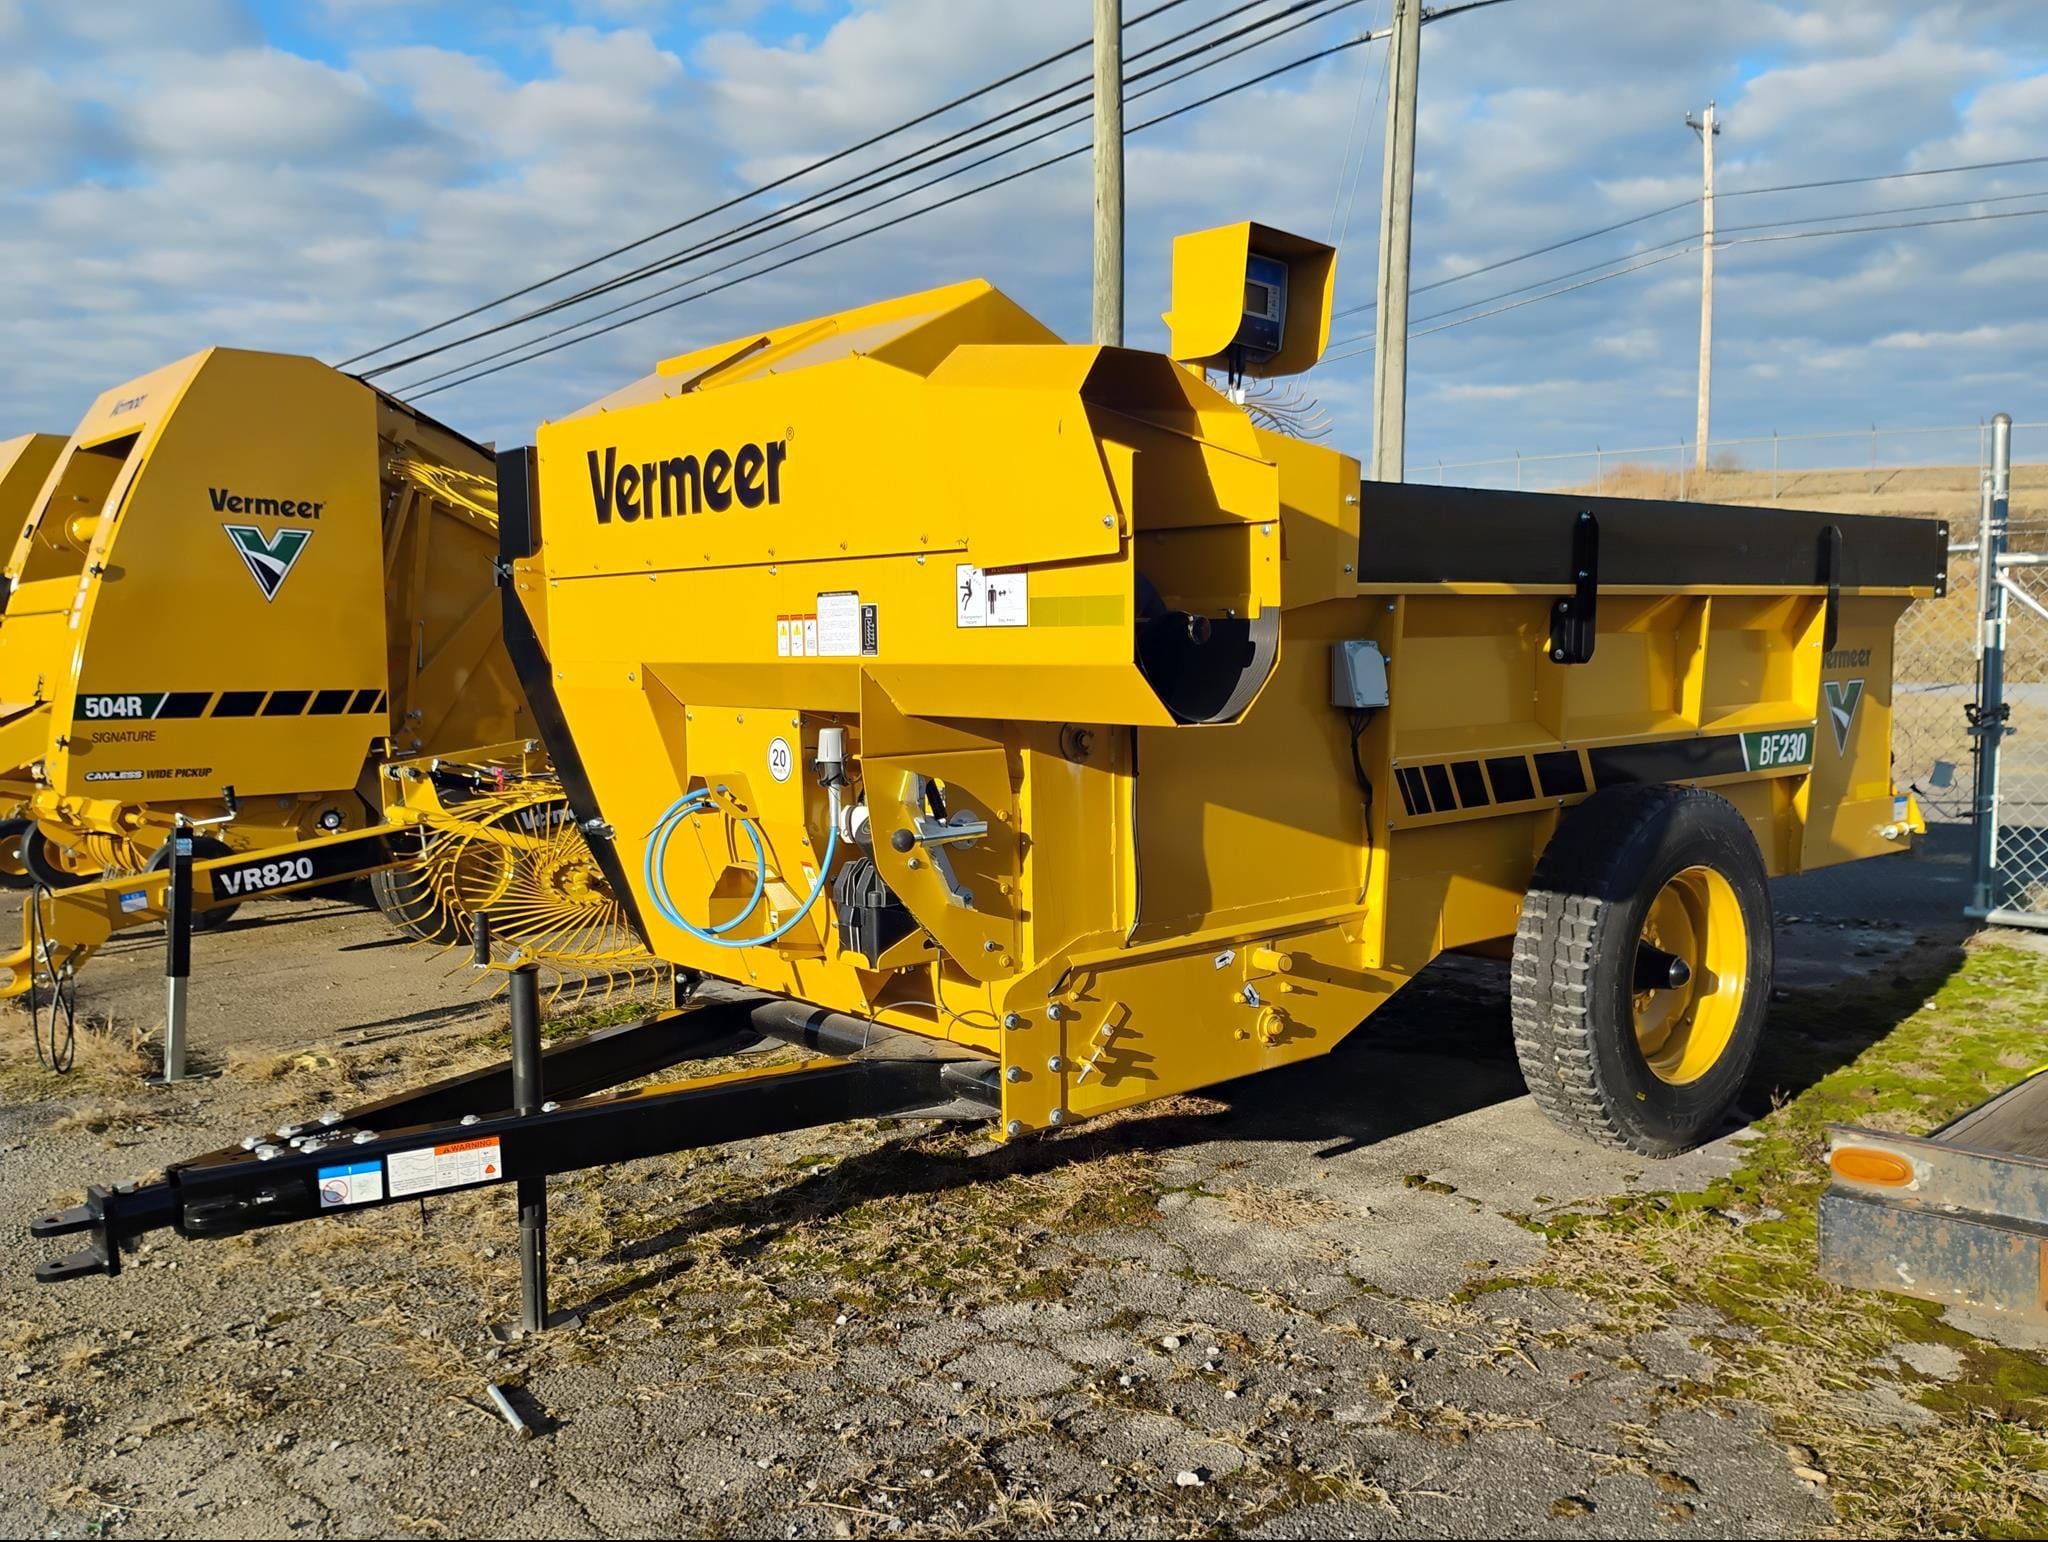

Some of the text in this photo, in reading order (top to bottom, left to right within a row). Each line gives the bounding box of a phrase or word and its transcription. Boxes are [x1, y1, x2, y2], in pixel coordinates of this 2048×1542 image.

[208, 487, 324, 519] Vermeer
[1822, 649, 1871, 669] ermeer
[85, 696, 143, 718] 504R
[91, 730, 157, 744] SIGNATURE
[772, 748, 787, 768] 20
[1759, 733, 1807, 766] BF230
[85, 767, 213, 781] CAMLESS WIDE PICKUP
[219, 857, 314, 895] VR820
[451, 1139, 493, 1153] WARNING
